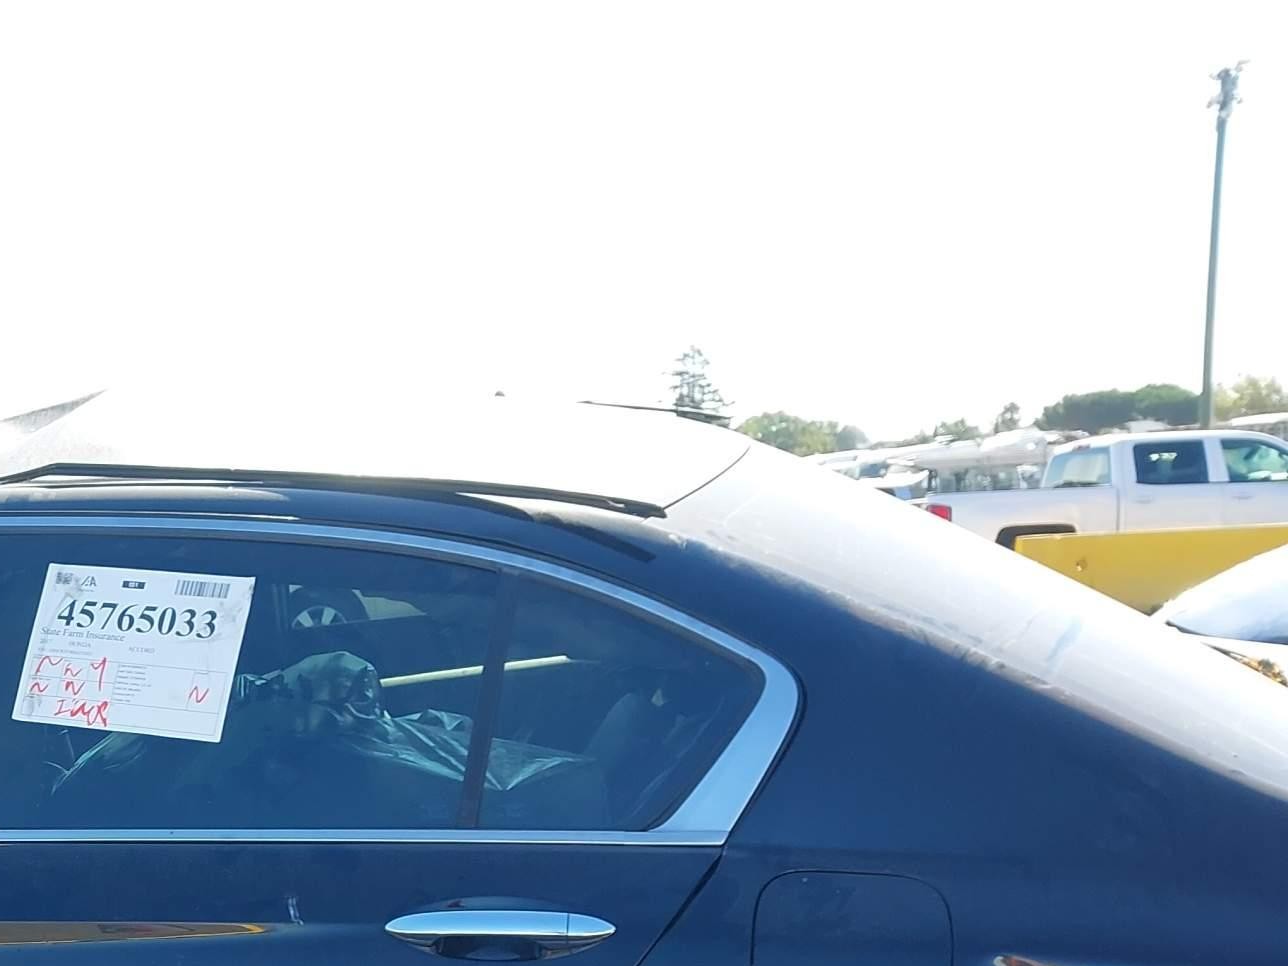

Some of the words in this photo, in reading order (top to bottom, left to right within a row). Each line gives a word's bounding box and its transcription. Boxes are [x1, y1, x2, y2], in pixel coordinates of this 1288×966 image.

[57, 599, 217, 639] 45765033
[40, 627, 61, 636] State
[63, 629, 84, 638] Farm
[86, 631, 125, 641] Insurance
